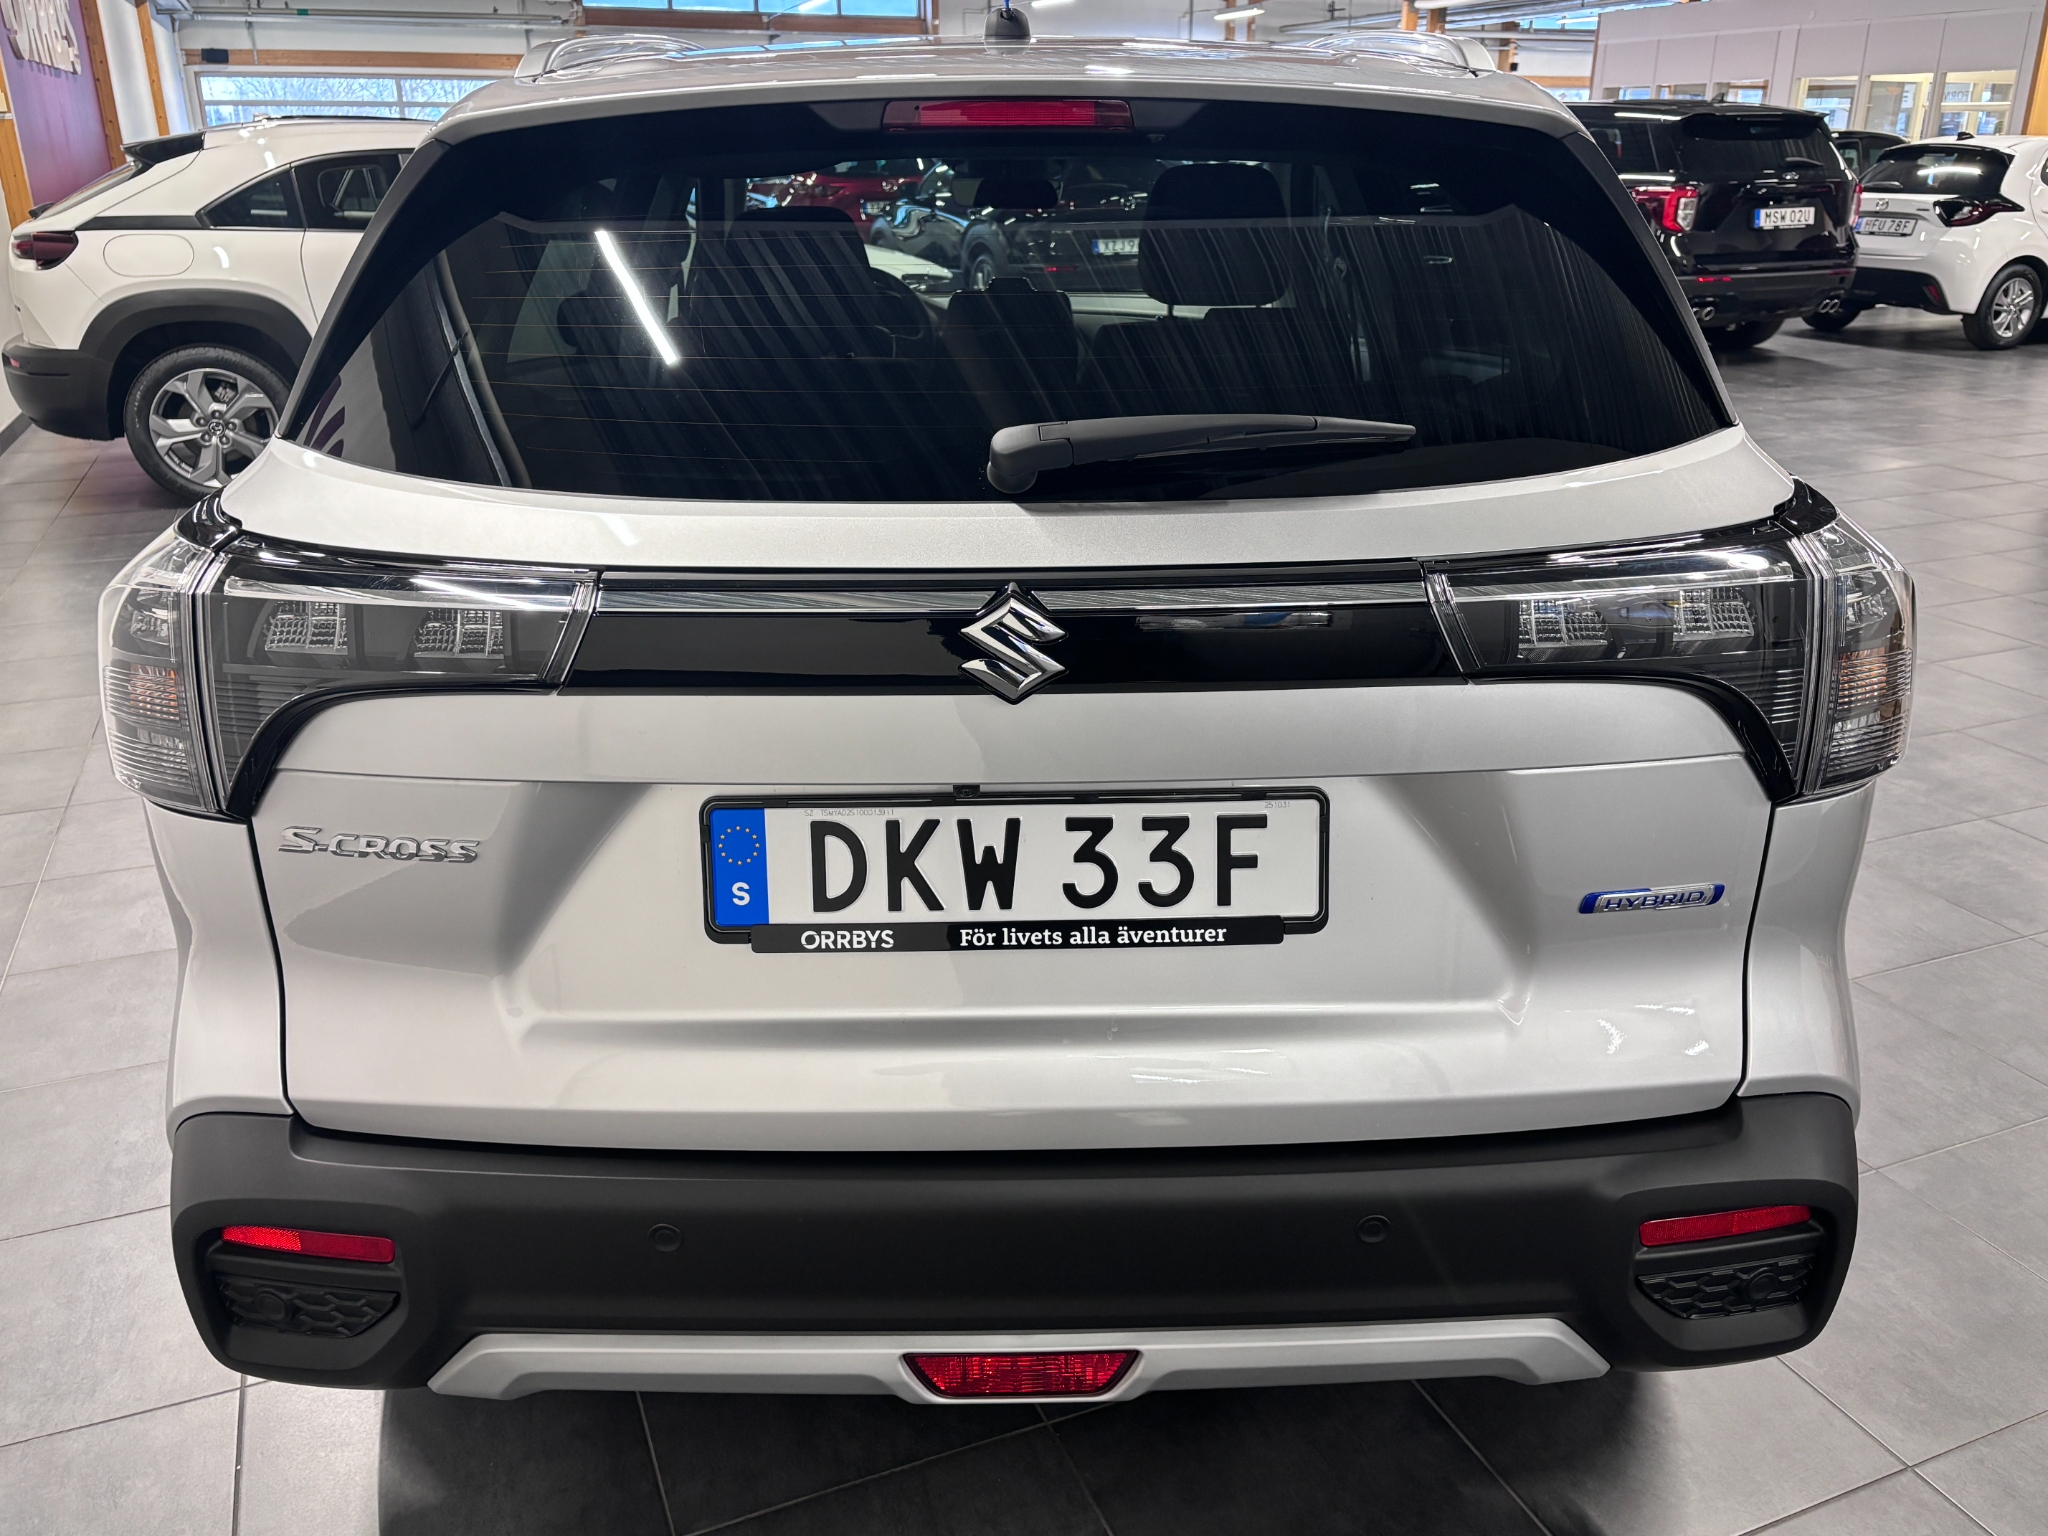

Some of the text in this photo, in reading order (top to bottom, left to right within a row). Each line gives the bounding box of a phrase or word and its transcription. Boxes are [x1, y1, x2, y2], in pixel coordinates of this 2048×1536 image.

[1764, 209, 1811, 225] MSW 02U
[1888, 219, 1911, 232] 78F
[1265, 801, 1291, 809] 251031
[278, 825, 480, 863] S-CROSS
[810, 813, 1267, 912] DKW 33F
[732, 882, 751, 906] S
[1603, 890, 1705, 911] HYBRID
[800, 929, 895, 949] ORRBYS
[959, 926, 1227, 947] För livets alla äventurer
